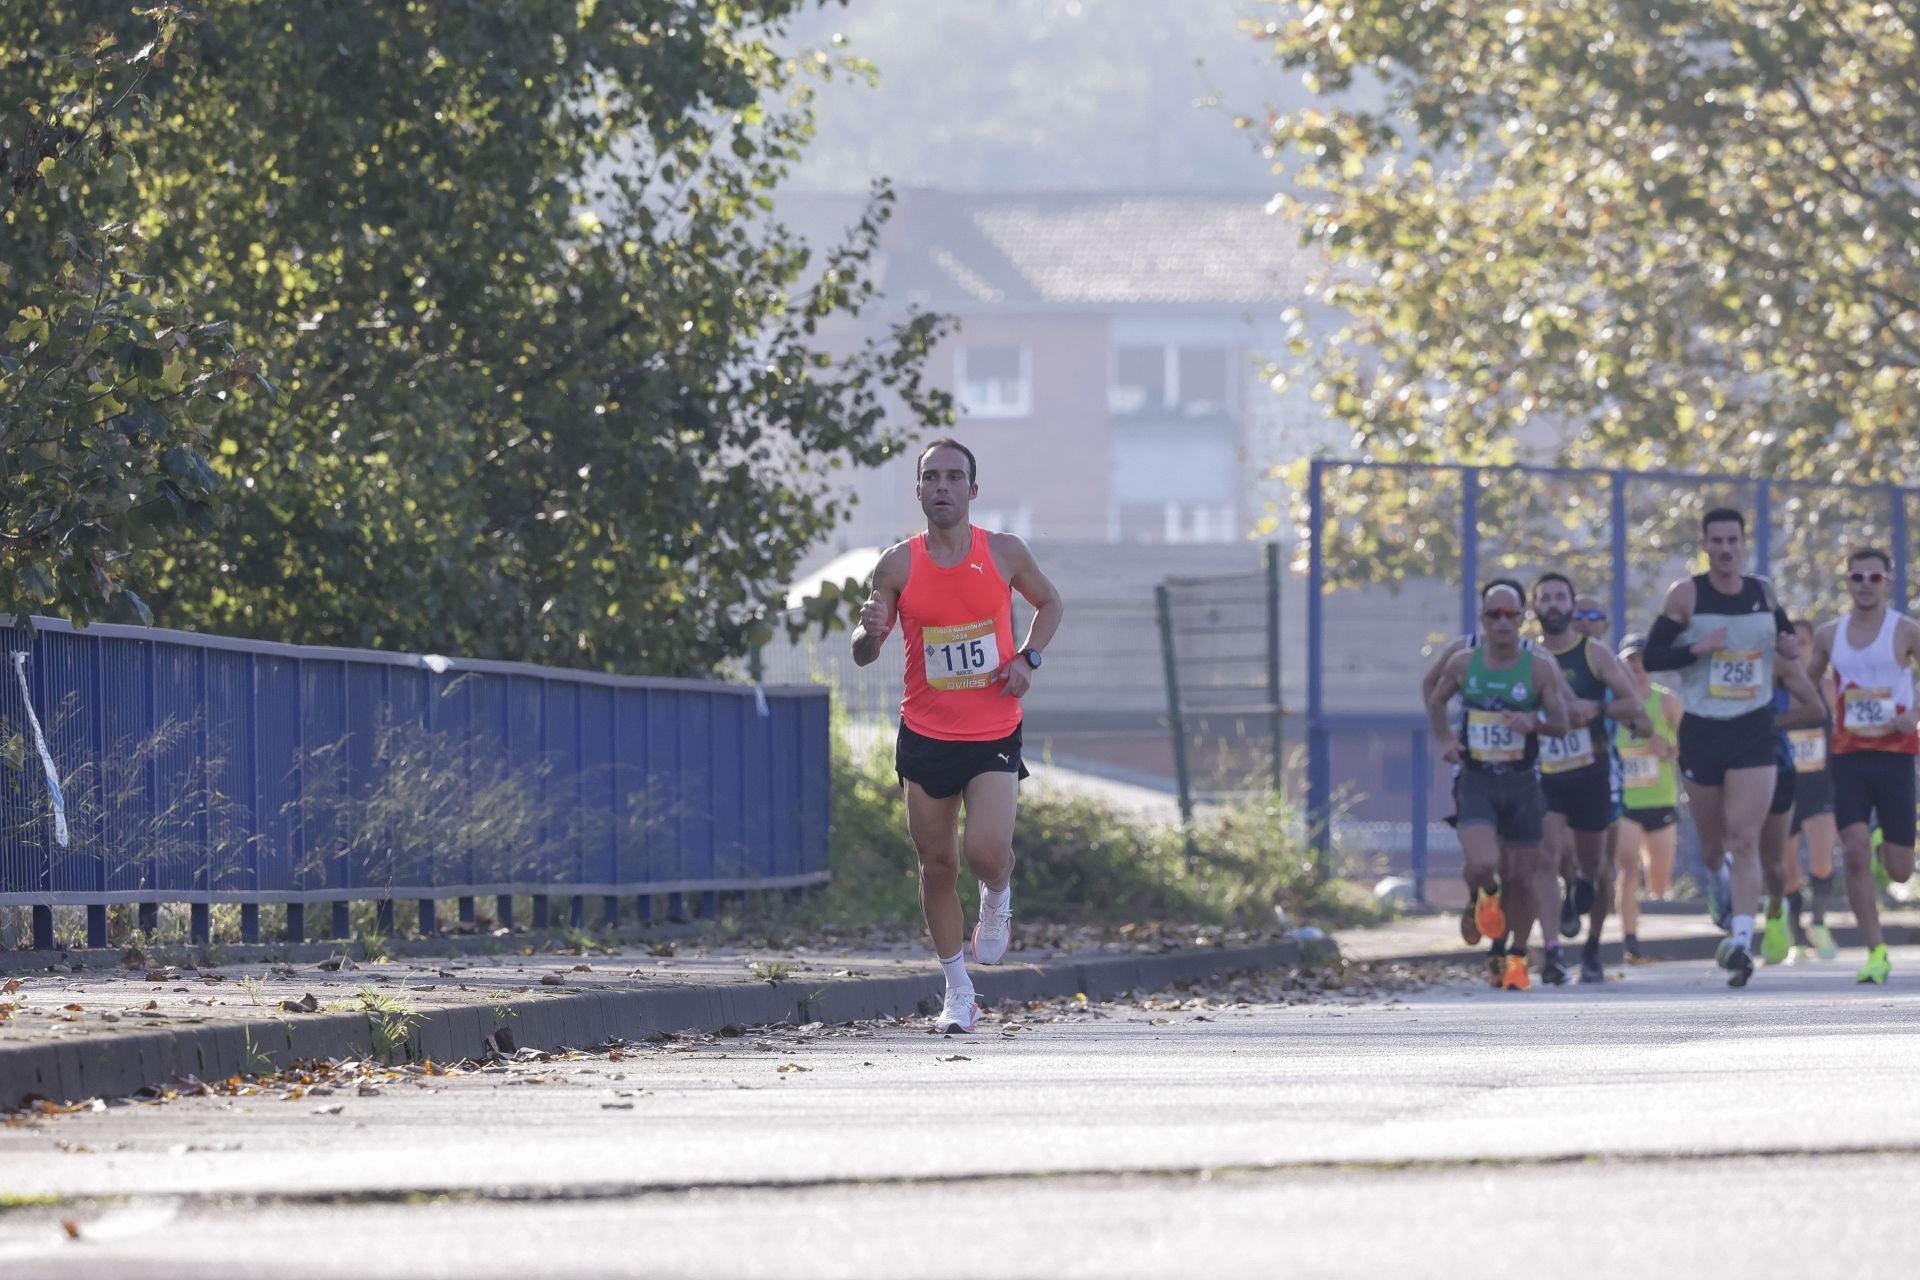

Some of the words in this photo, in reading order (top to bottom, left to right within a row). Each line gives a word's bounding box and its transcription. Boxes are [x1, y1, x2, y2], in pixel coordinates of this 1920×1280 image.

[941, 640, 985, 671] 115
[1482, 726, 1512, 746] 153
[1548, 732, 1580, 757] 410
